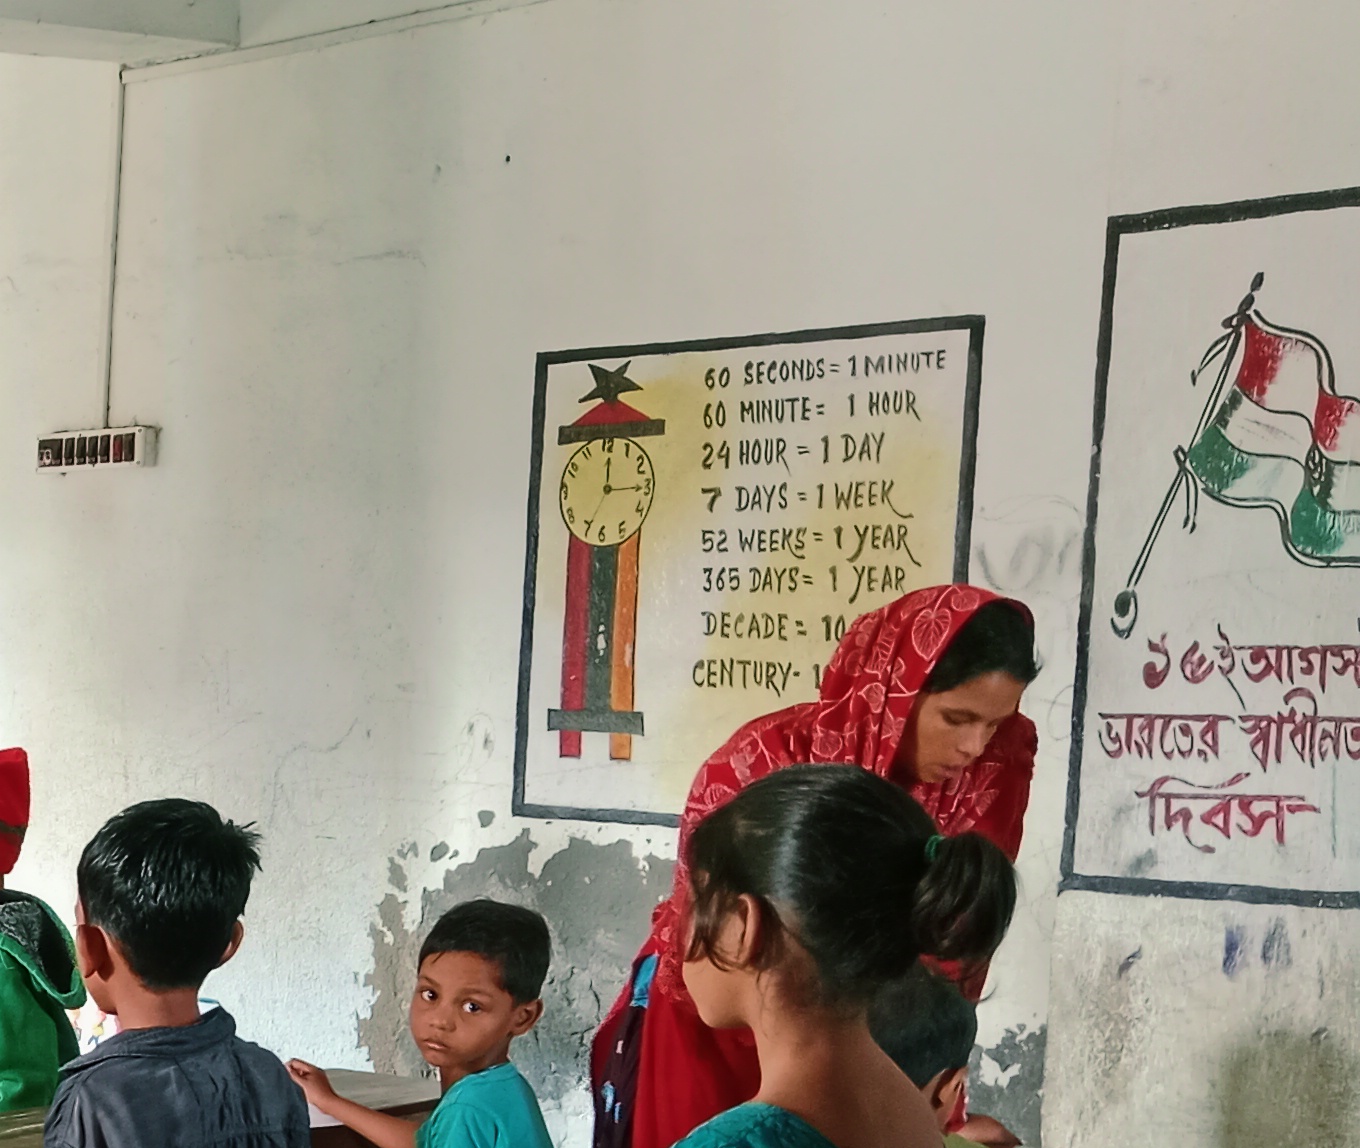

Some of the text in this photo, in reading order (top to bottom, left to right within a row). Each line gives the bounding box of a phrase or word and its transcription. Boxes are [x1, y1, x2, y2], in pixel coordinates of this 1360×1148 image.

[704, 366, 730, 390] 60
[743, 357, 825, 386] SECONDS
[847, 355, 857, 377] 1
[864, 349, 946, 377] MINUTE
[703, 400, 726, 429] 60
[740, 396, 811, 424] MINUTE
[847, 393, 855, 417] 1
[868, 389, 921, 422] HOUR
[602, 438, 614, 453] 12
[636, 454, 646, 474] 2
[701, 440, 730, 470] 24
[739, 437, 792, 477] HOUR
[821, 435, 830, 464] 1
[840, 431, 885, 464] DAY
[643, 478, 651, 496] 3
[701, 486, 722, 513] 7
[734, 481, 788, 513] DAYS
[816, 483, 825, 509] 1
[834, 479, 914, 518] WEEK
[598, 525, 606, 542] 6
[701, 529, 729, 553] 52
[738, 527, 807, 559] WEEKS
[833, 525, 844, 549] 1
[846, 523, 922, 567] YEAR
[702, 566, 741, 593] 365
[749, 566, 799, 594] DAYS
[828, 565, 837, 592] 1
[848, 565, 906, 604] YEAR
[701, 611, 789, 642] DECADE
[821, 614, 846, 643] 10
[1098, 687, 1360, 774] ভারতের স্বাধীনত
